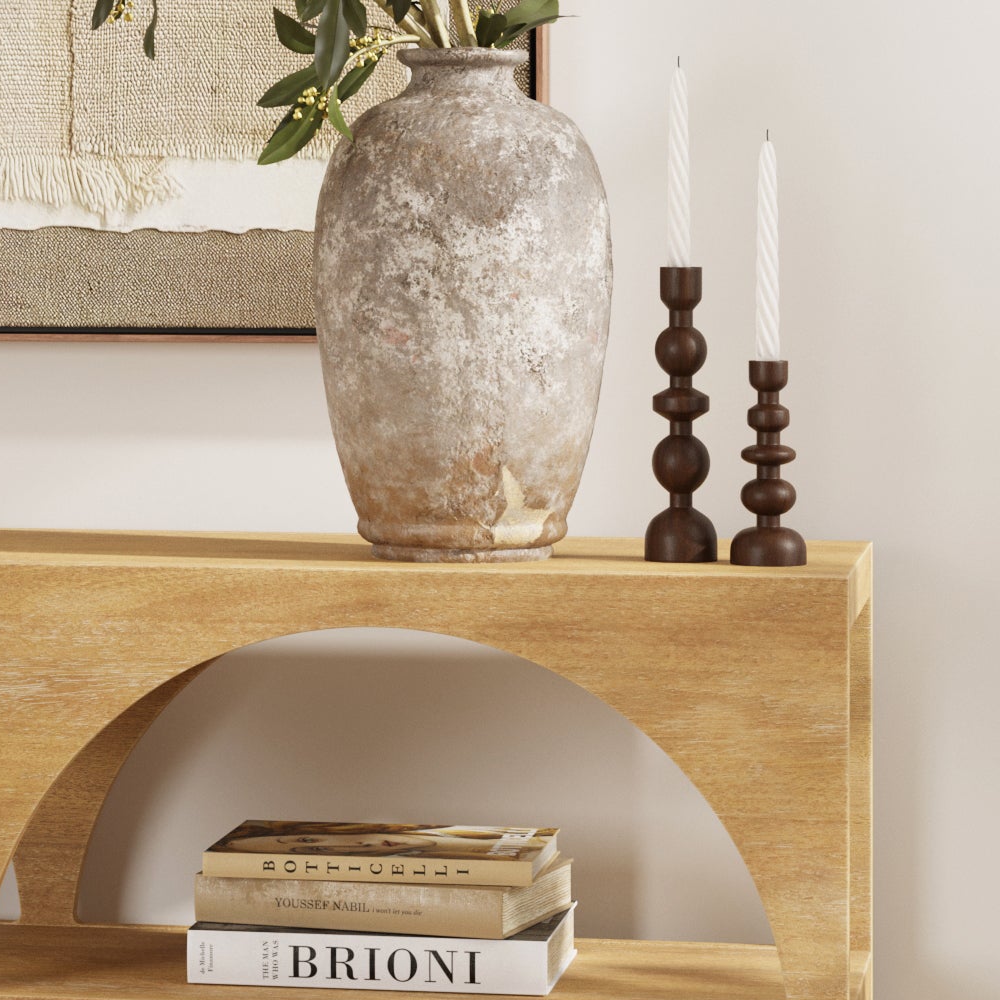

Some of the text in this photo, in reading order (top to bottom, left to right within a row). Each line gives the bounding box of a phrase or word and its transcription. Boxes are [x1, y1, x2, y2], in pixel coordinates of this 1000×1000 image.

[262, 860, 470, 877] BOTTICELLI
[275, 897, 330, 910] YOUSSEF
[332, 900, 370, 913] NABIL
[288, 945, 481, 984] BRIONI
